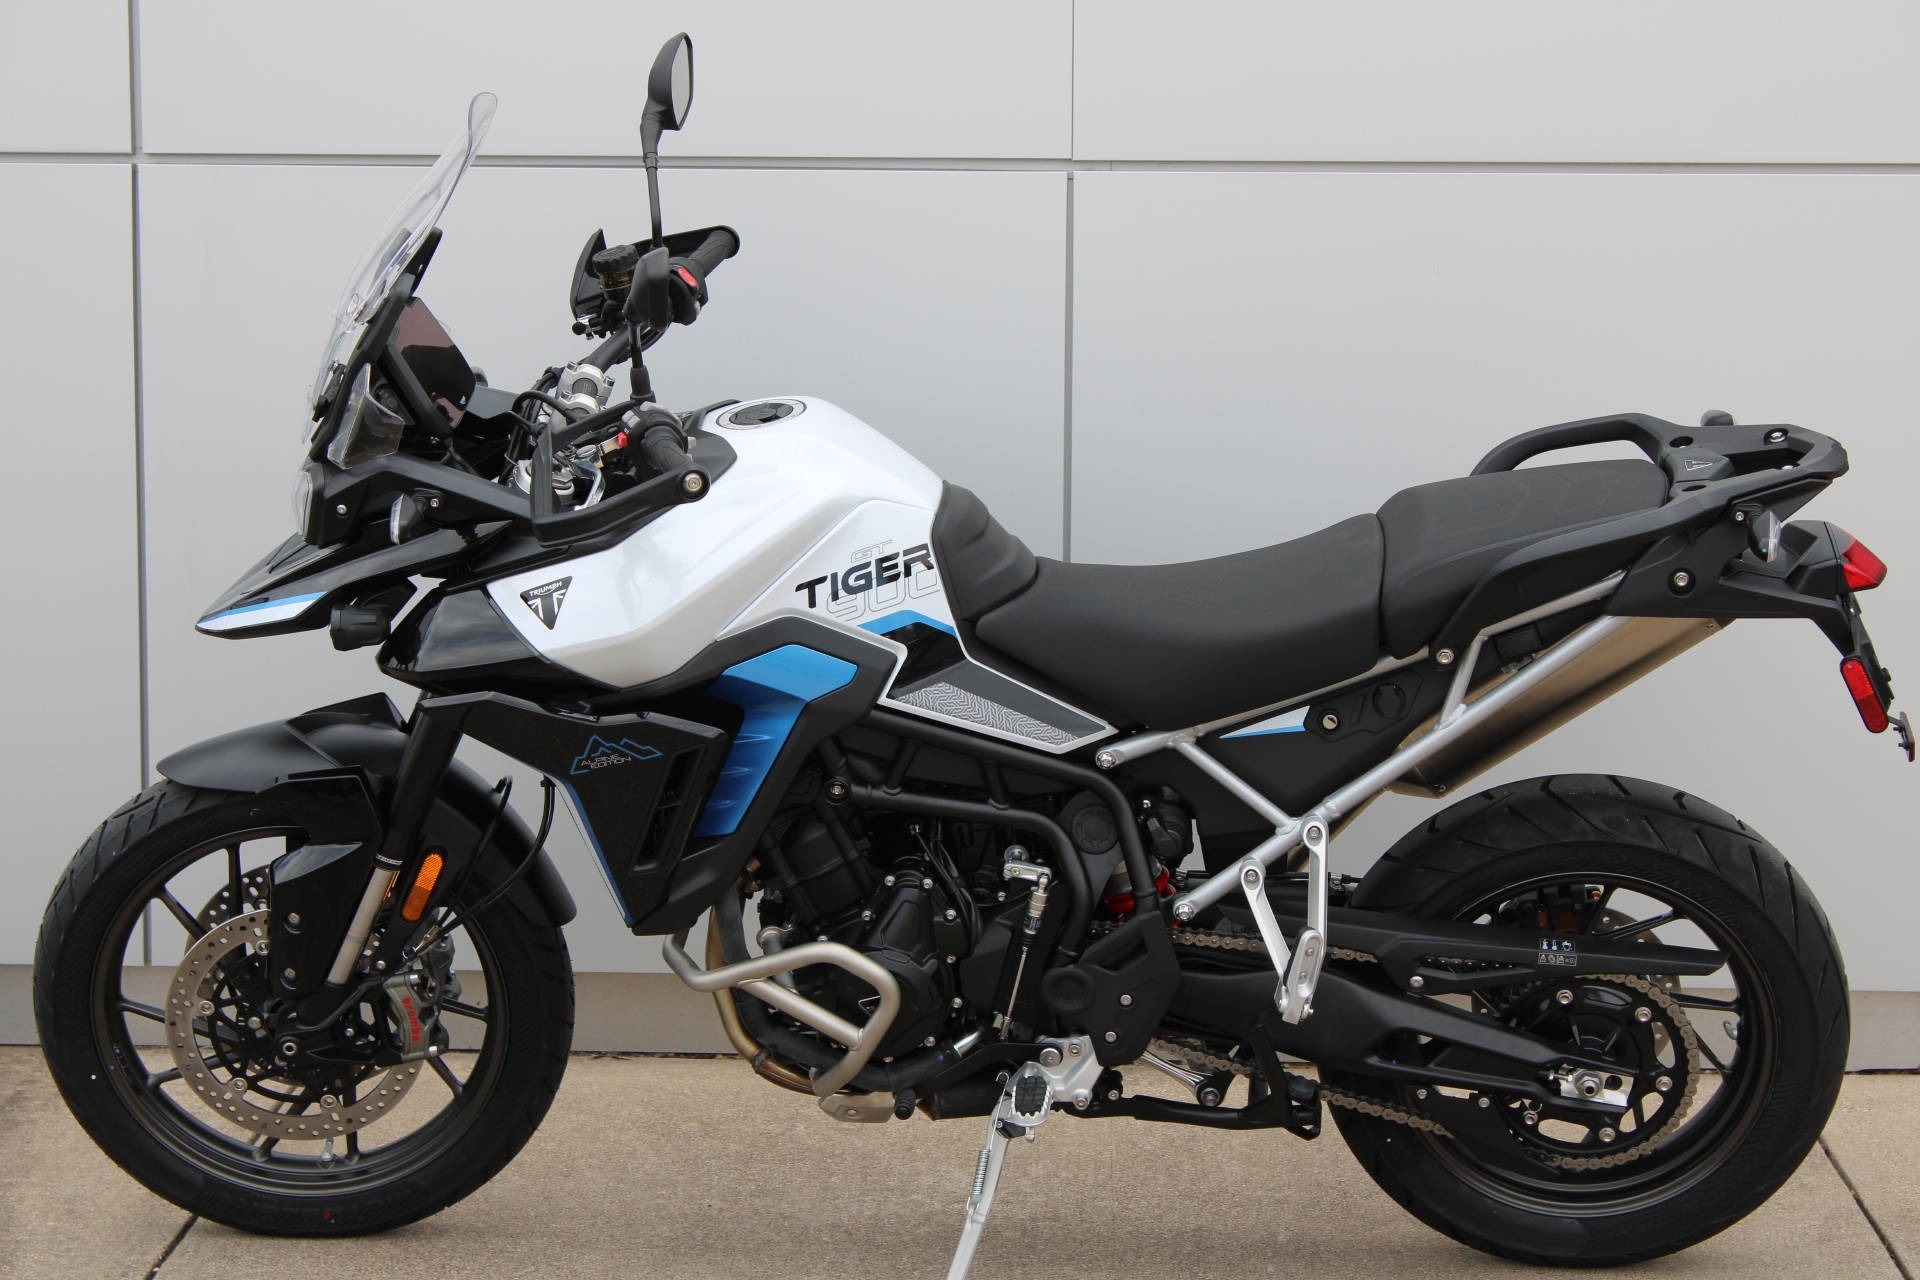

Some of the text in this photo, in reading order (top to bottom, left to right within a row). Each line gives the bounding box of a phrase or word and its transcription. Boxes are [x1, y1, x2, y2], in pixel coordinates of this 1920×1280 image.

[851, 539, 892, 562] GT
[795, 543, 934, 608] TIGER
[529, 581, 562, 596] TRIUMPH
